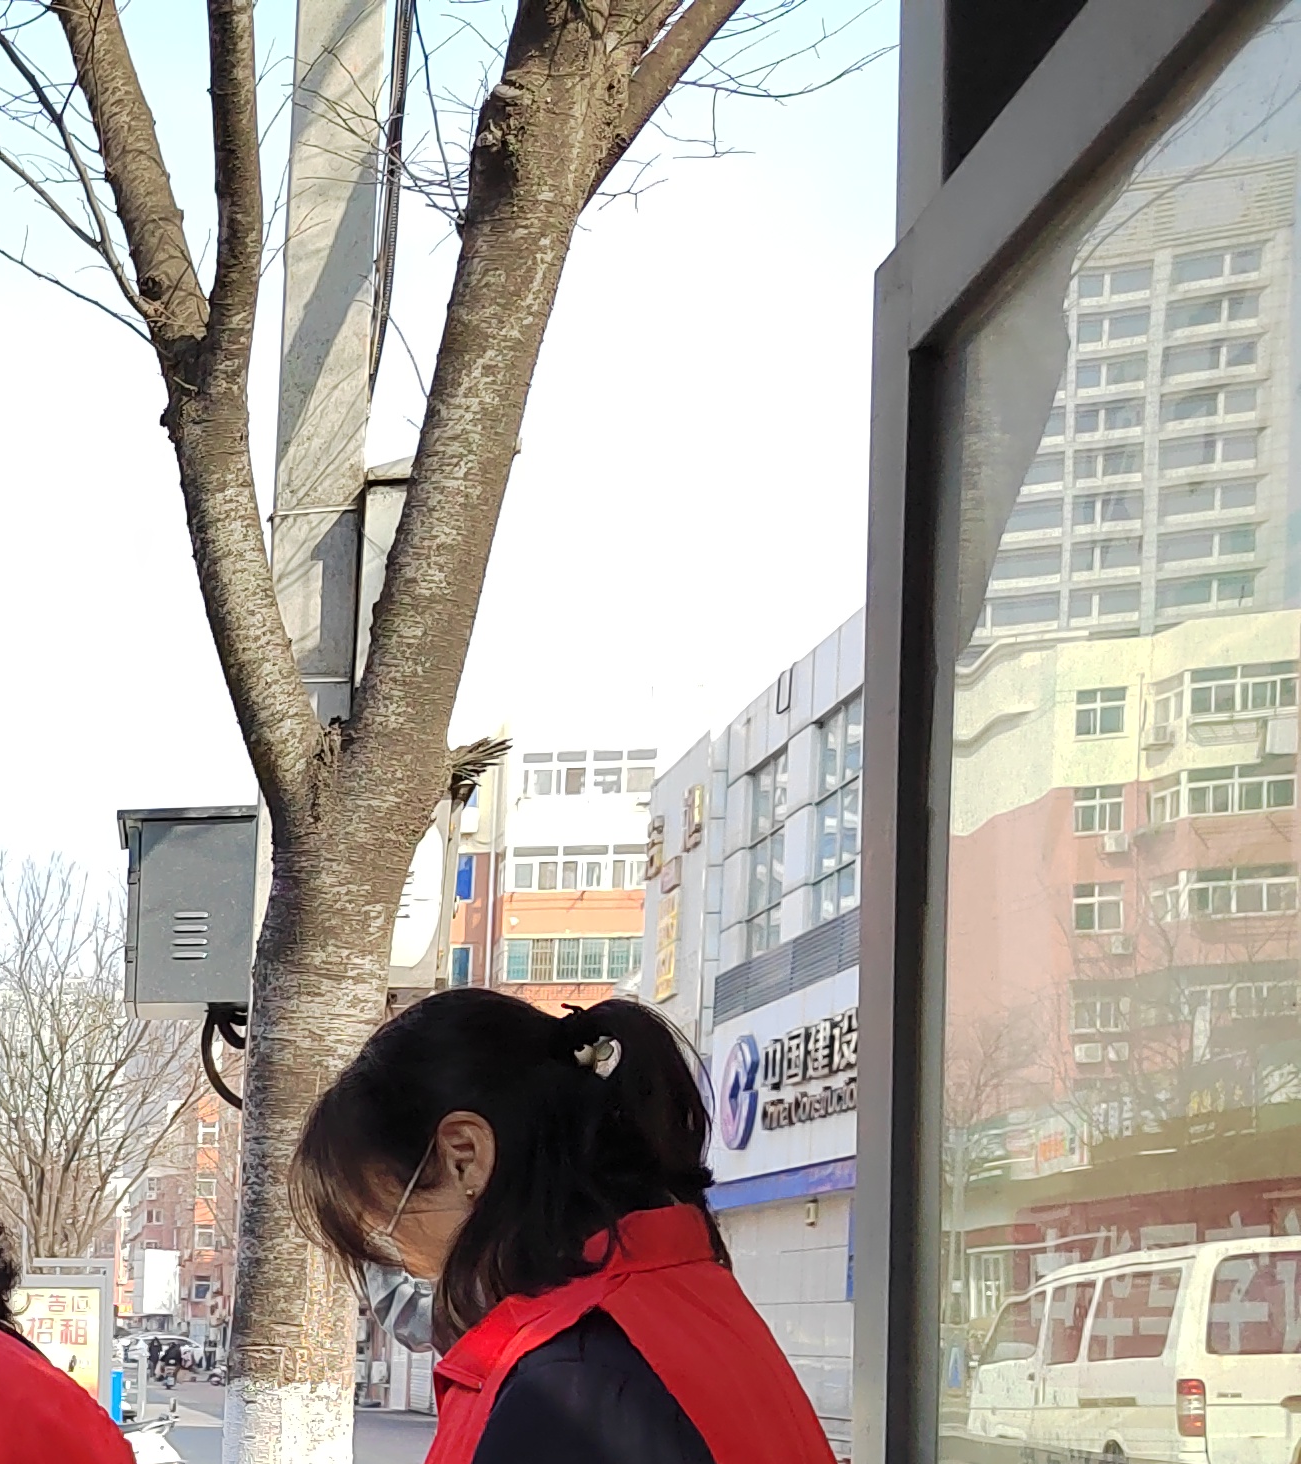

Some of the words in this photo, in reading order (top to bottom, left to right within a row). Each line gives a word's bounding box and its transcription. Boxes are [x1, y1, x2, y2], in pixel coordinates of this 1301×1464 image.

[761, 1006, 859, 1091] 中国建设
[26, 1317, 88, 1346] 招租
